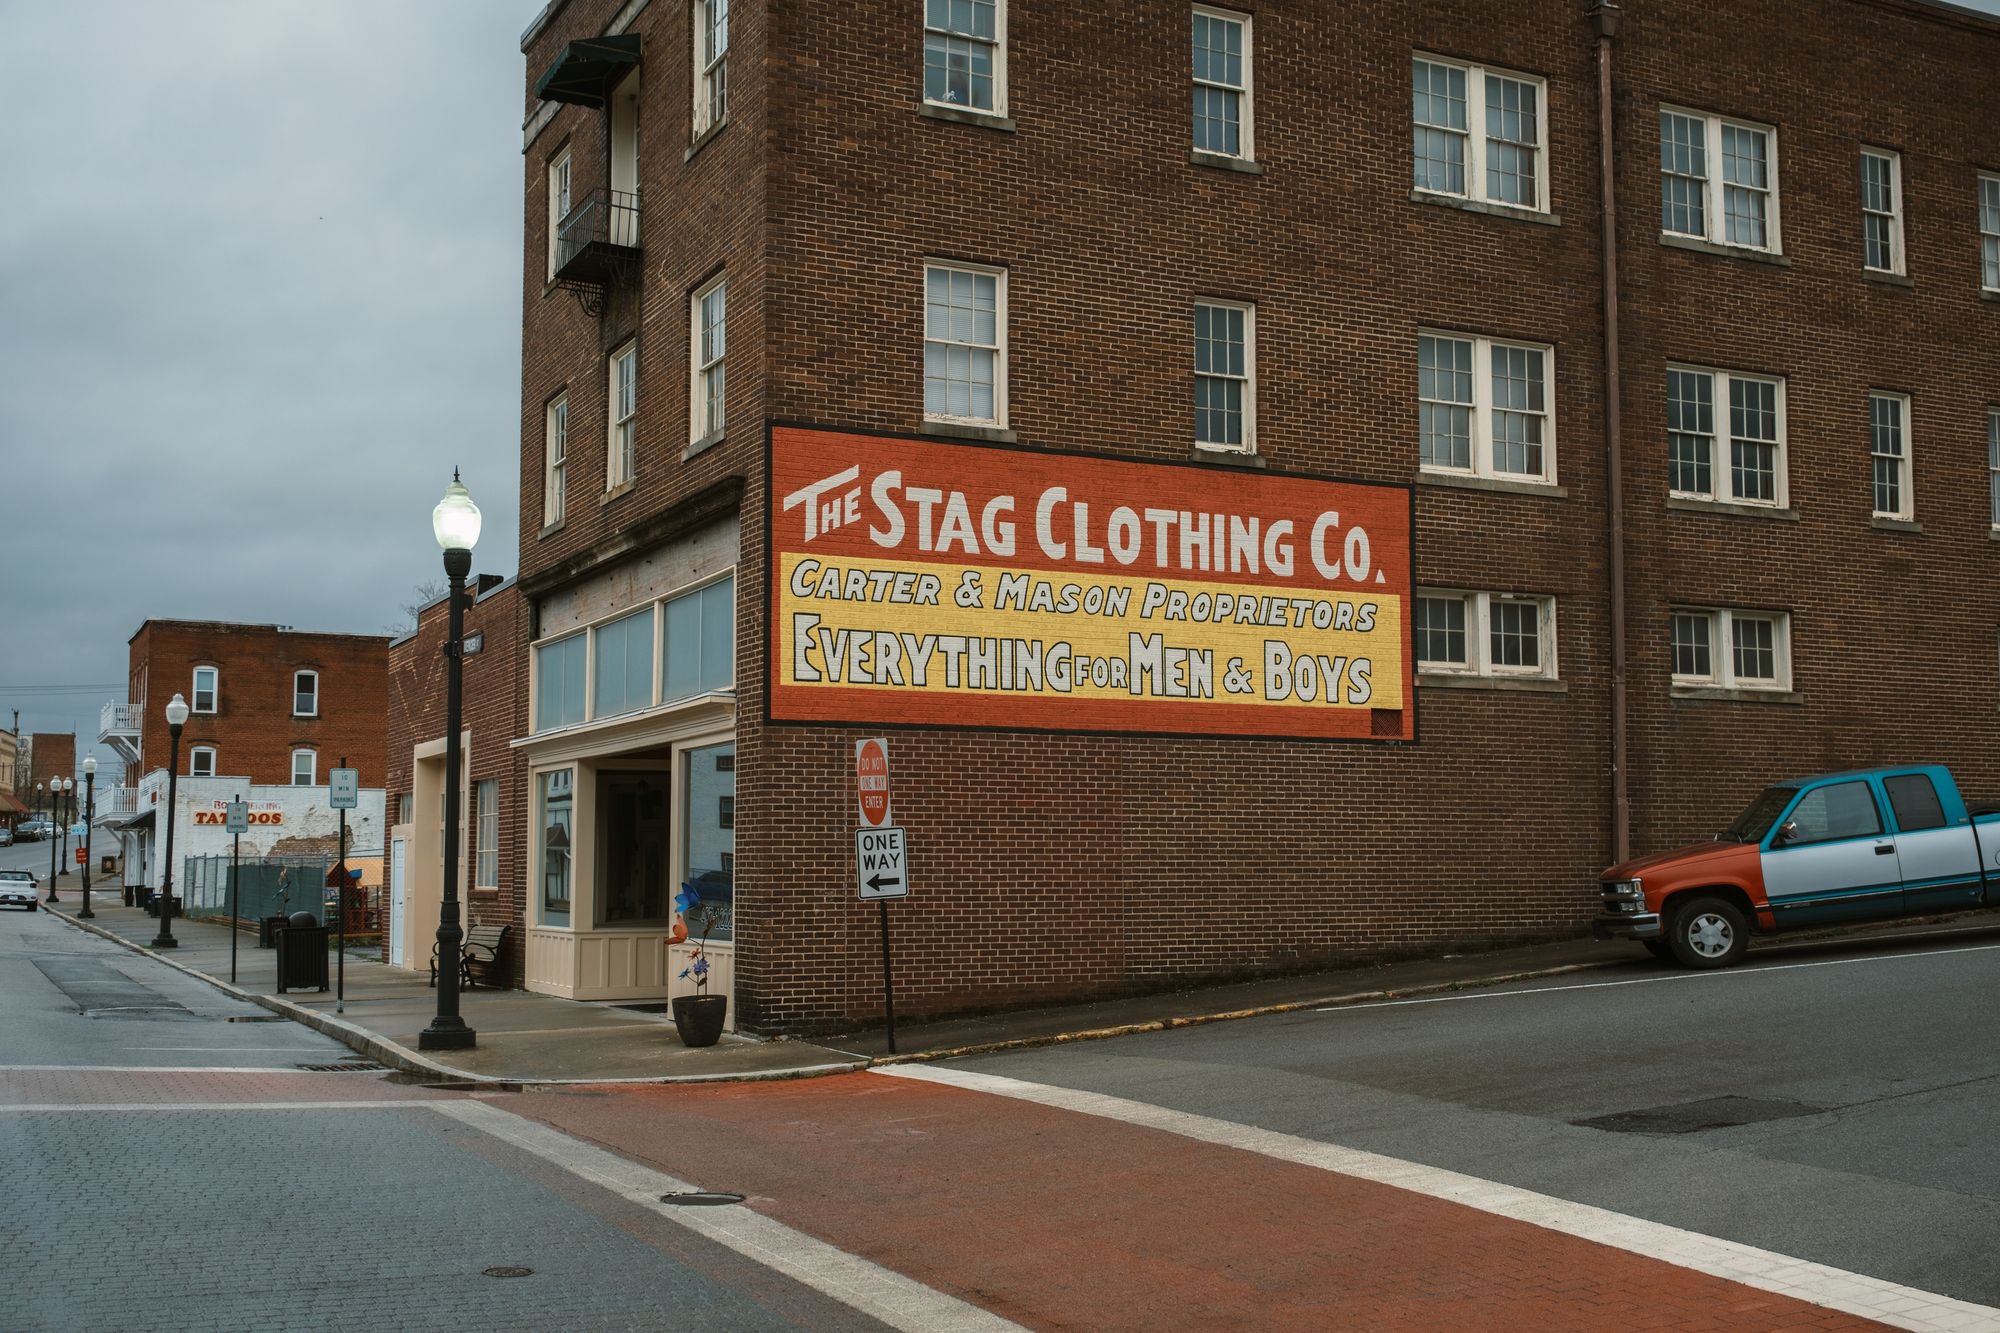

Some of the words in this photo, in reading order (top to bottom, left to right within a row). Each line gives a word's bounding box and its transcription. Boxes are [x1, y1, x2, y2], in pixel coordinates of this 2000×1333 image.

[783, 464, 862, 543] THE
[869, 470, 1016, 557] STAG
[1035, 486, 1294, 577] CLOTHING
[1310, 511, 1386, 583] CO.
[790, 559, 941, 605] CARTER
[954, 570, 984, 608] &
[994, 572, 1132, 617] MASON
[1140, 583, 1378, 632] PROPRIETORS
[793, 612, 1072, 692] EVERYTHING
[1074, 655, 1128, 689] FOR
[1129, 632, 1214, 698] MEN
[1222, 657, 1254, 694] &
[1264, 639, 1373, 705] BOYS
[861, 758, 869, 771] DO
[871, 757, 883, 770] NOT
[861, 776, 872, 790] ONE
[874, 775, 885, 789] WAY
[865, 795, 884, 809] ENTER
[863, 833, 899, 852] ONE
[863, 852, 900, 871] WAY
